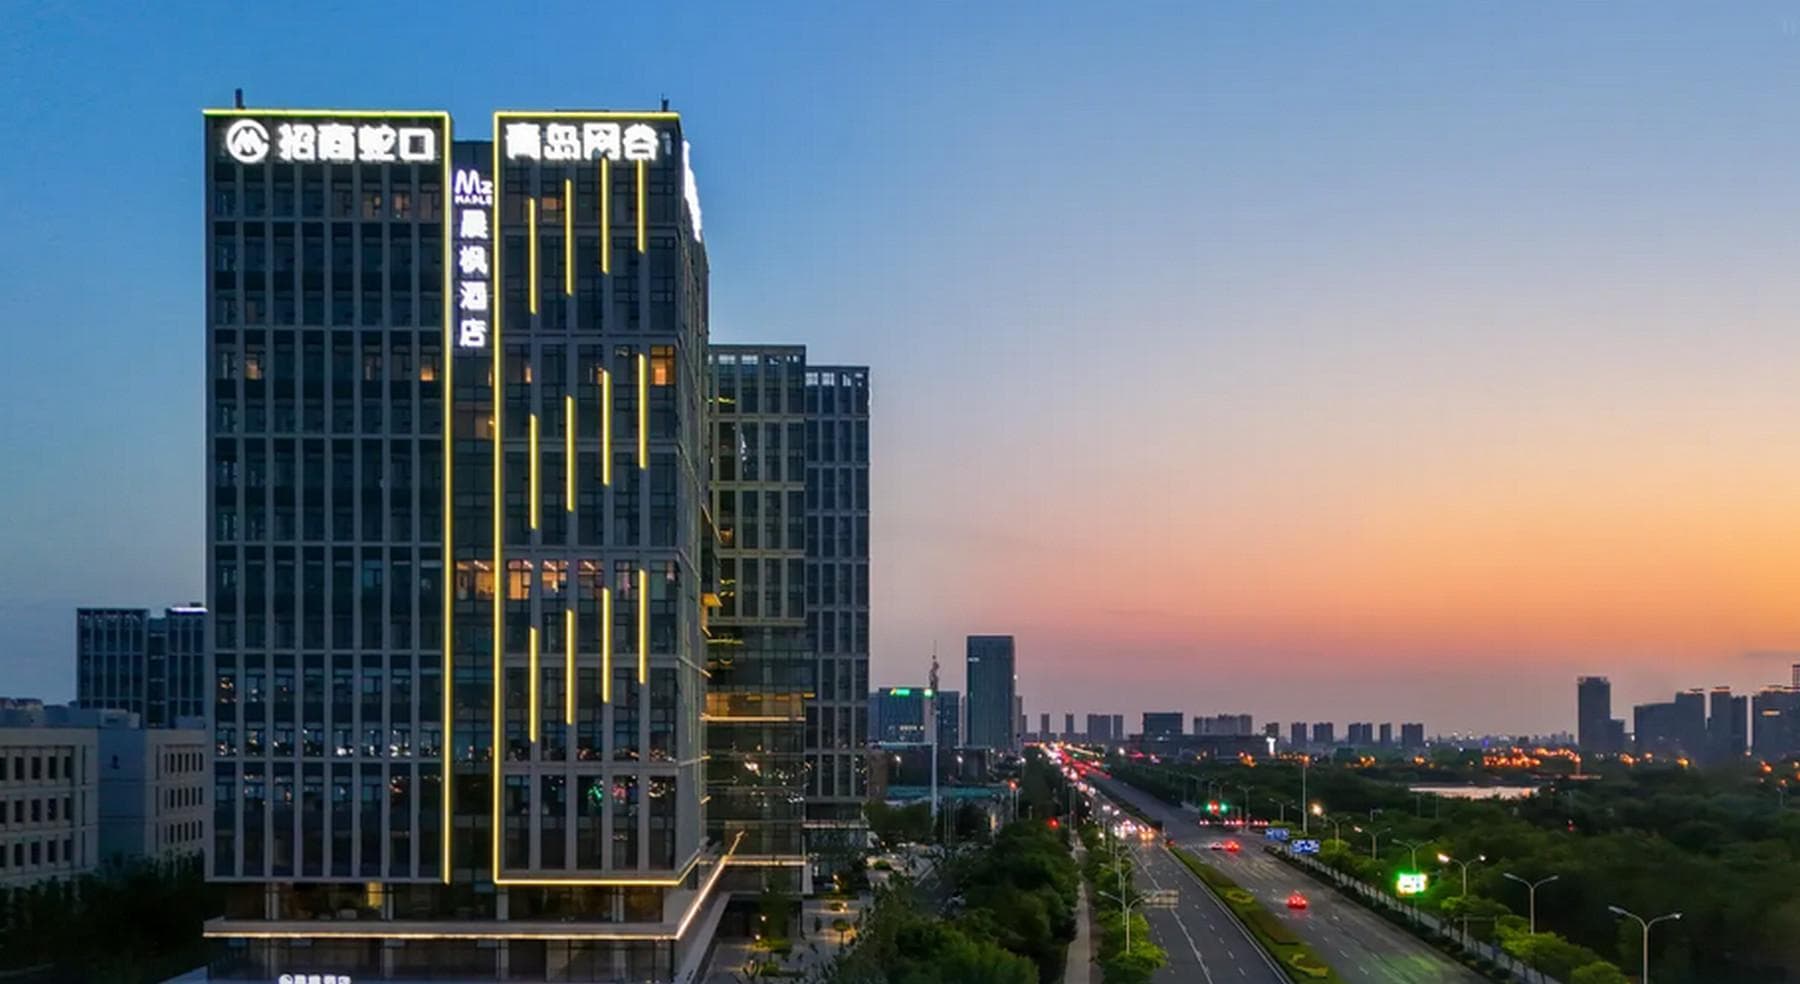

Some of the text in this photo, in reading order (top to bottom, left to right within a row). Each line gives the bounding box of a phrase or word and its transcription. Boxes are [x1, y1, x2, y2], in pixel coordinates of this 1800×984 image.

[278, 122, 436, 162] 招商蛇口
[505, 122, 659, 161] 青岛网谷
[459, 209, 488, 347] 晨枫酒店
